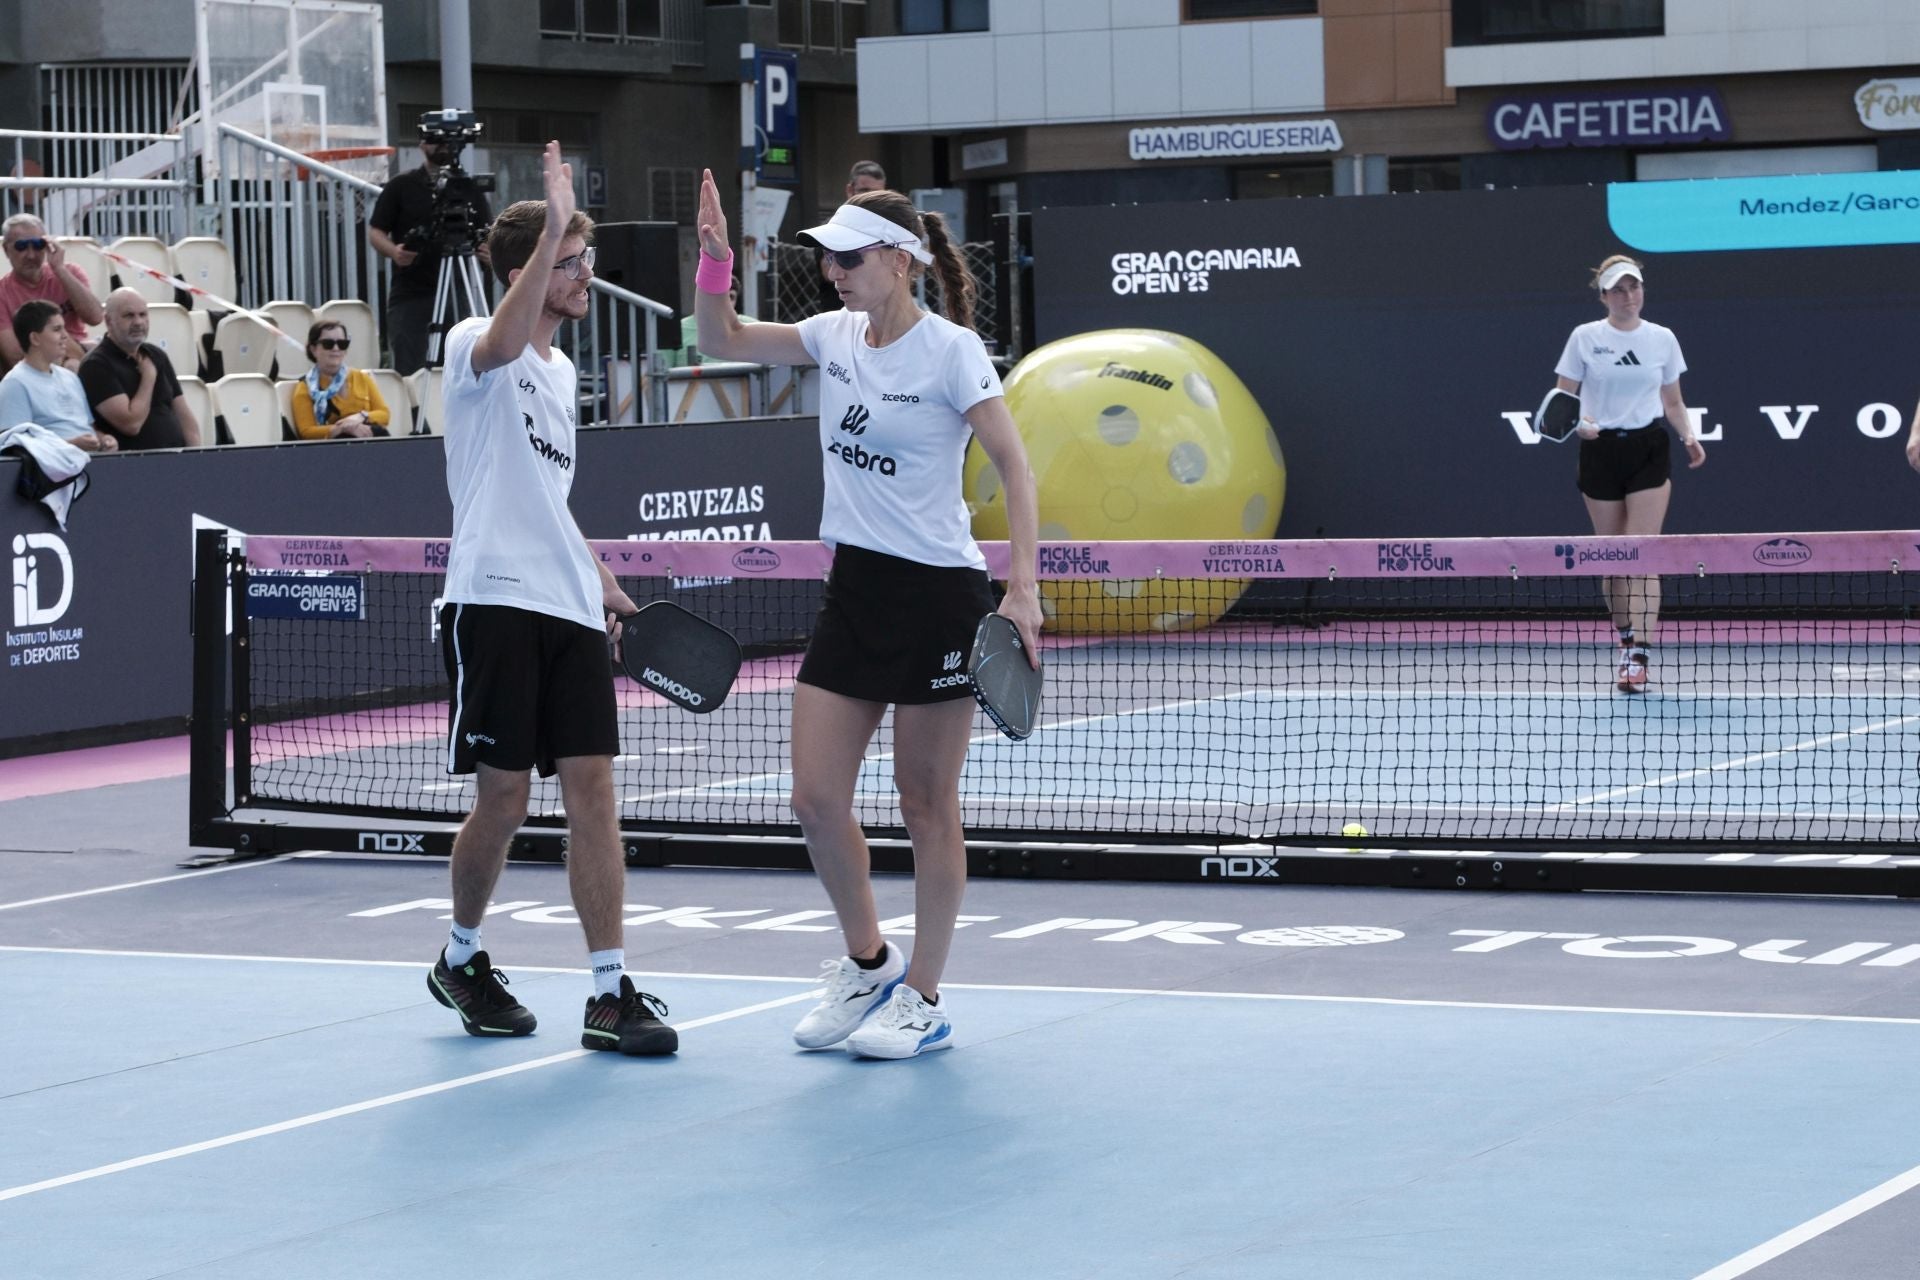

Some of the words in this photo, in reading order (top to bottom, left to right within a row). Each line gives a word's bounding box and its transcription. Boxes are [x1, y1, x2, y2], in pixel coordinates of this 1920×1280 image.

[765, 64, 789, 133] P
[1494, 96, 1722, 141] CAFETERIA
[1135, 126, 1336, 153] HAMBURGUESERIA
[1185, 246, 1301, 271] CANARIA
[1111, 272, 1180, 295] OPEN
[882, 393, 919, 403] zcebra
[1501, 402, 1902, 445] VLVO
[639, 485, 764, 521] CERVEZAS
[285, 540, 344, 551] CERVEZAS
[1039, 546, 1091, 561] PICKLE
[1208, 544, 1279, 556] CERVEZAS
[1378, 543, 1433, 558] PICKLE
[280, 553, 349, 567] VICTORIA
[1579, 548, 1639, 565] picklebull
[1202, 558, 1286, 573] VICTORIA
[291, 584, 357, 598] CANARIA
[300, 598, 341, 612] OPEN
[23, 643, 80, 665] DEPORTES
[642, 667, 703, 706] KOMODO
